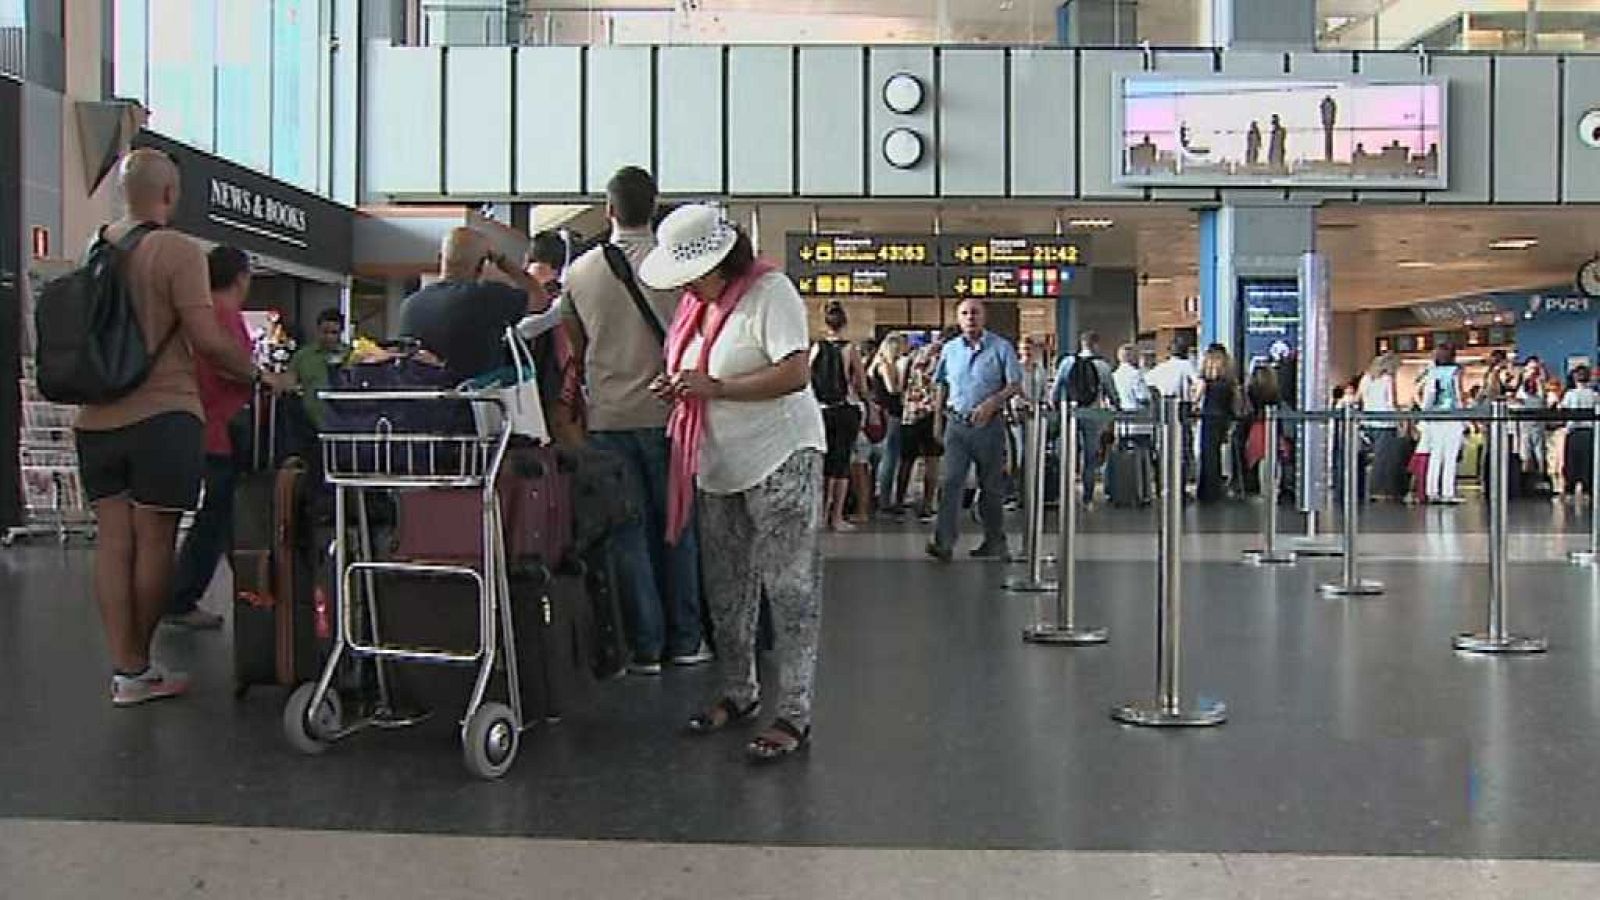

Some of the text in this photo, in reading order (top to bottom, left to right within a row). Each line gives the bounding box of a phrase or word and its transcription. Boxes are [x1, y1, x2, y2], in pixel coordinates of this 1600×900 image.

[210, 178, 306, 232] NEWS & BOOKS
